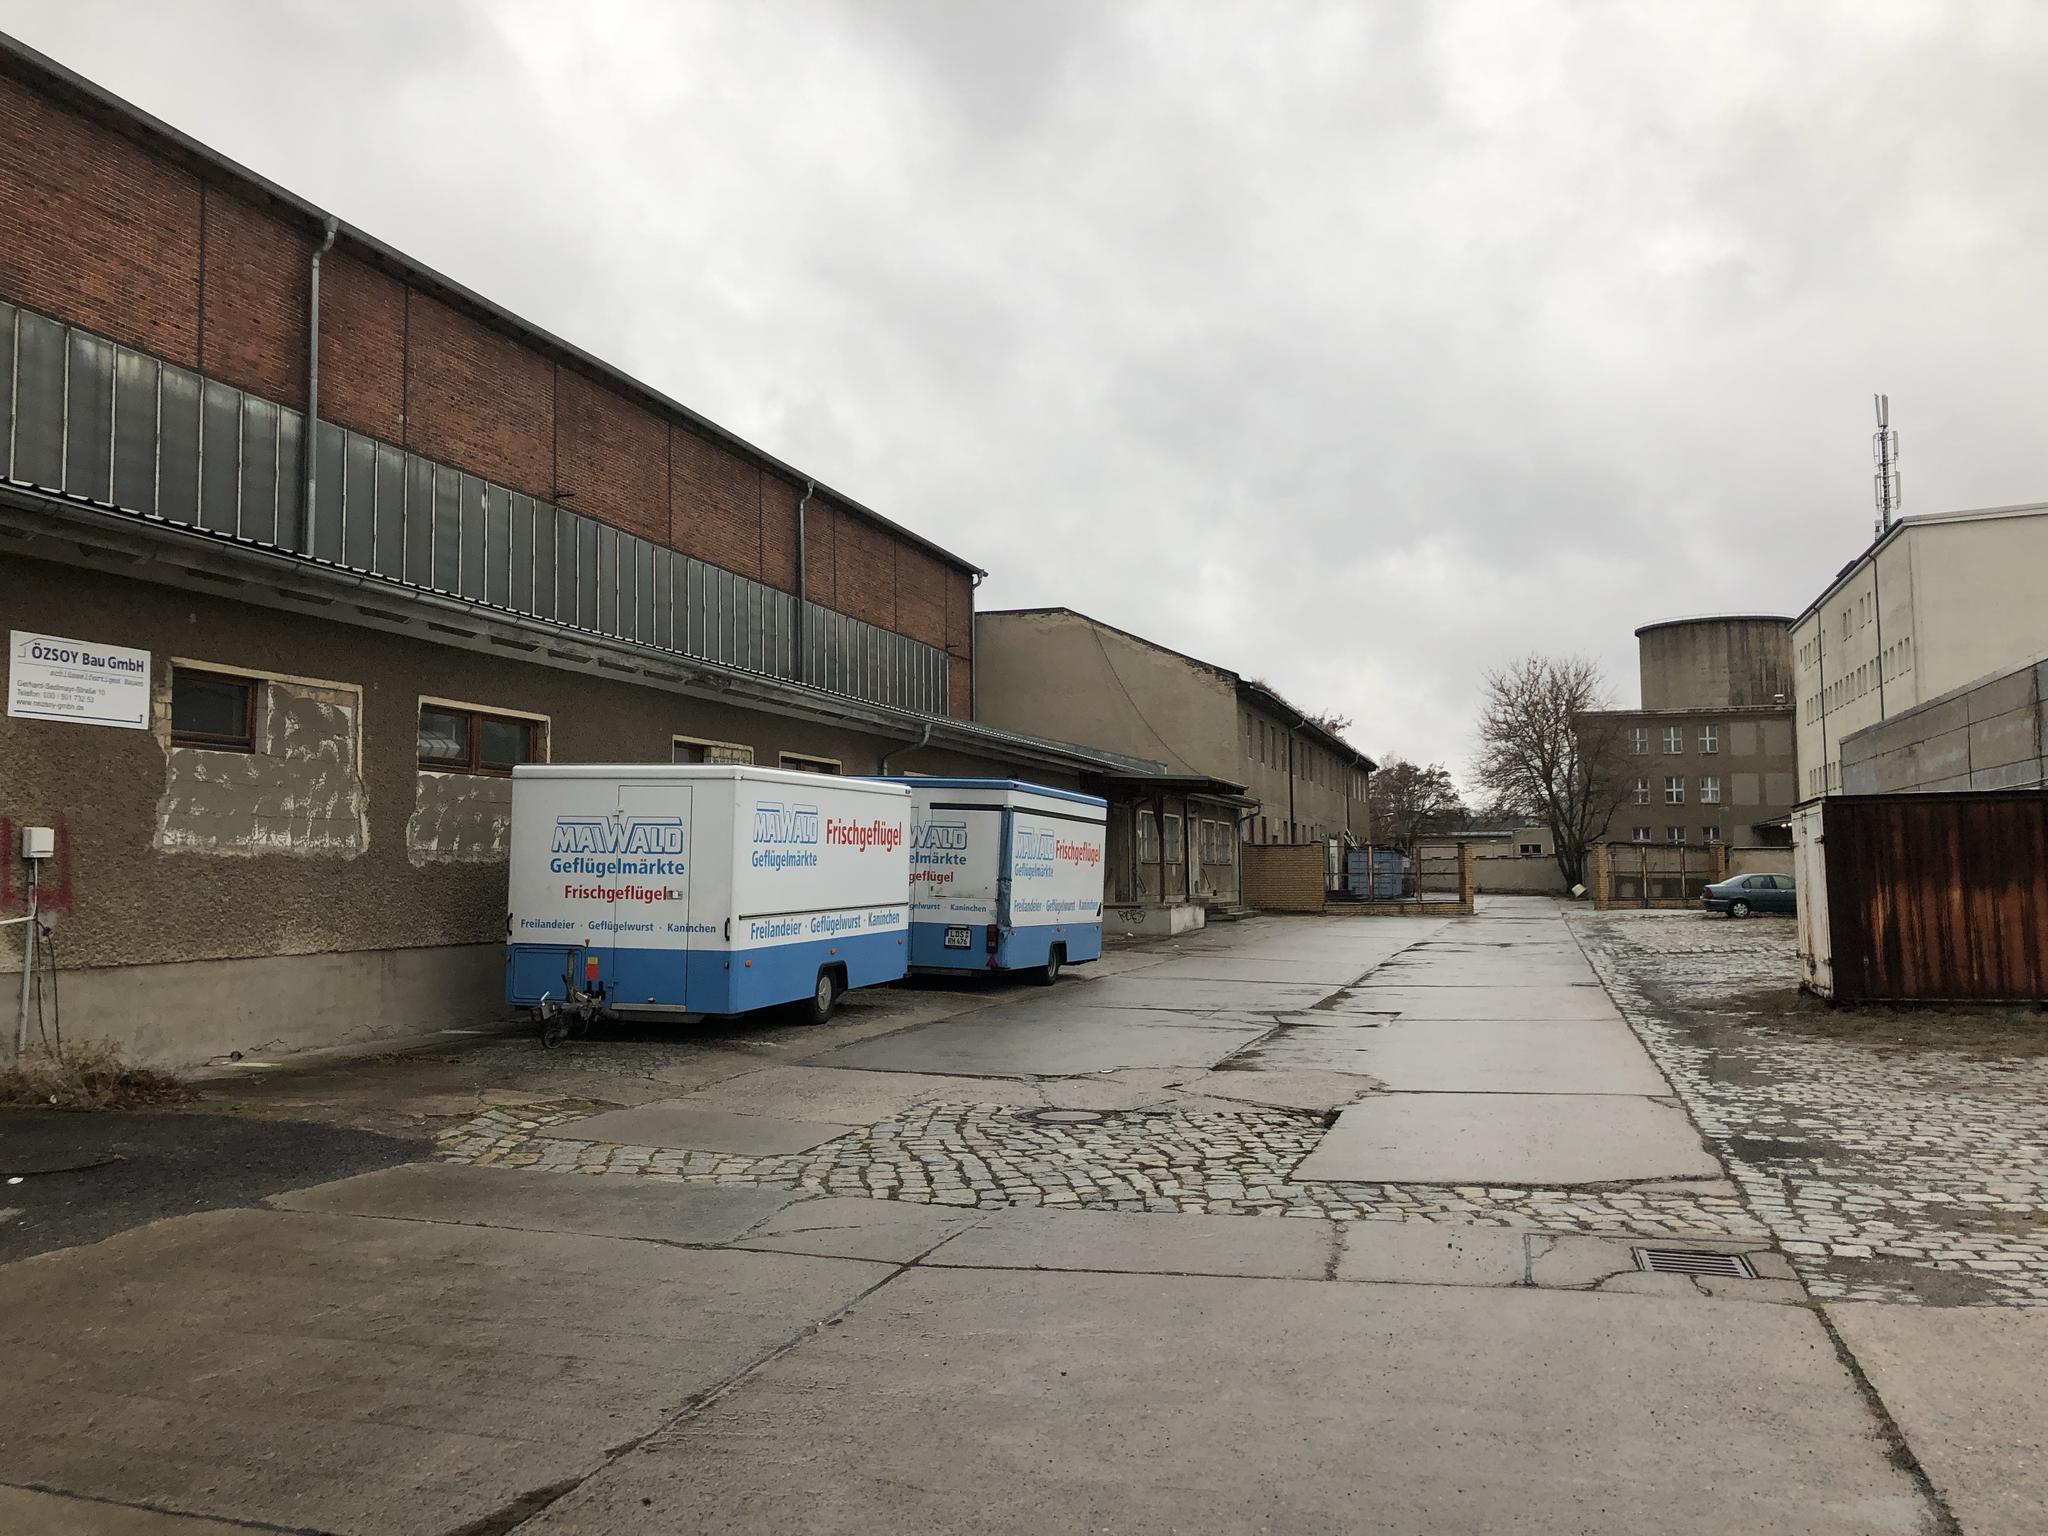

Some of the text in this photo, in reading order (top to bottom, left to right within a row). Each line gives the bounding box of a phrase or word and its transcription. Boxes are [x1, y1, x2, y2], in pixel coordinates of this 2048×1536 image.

[31, 642, 145, 673] ÖZSOY Bau GmbH
[826, 817, 902, 853] Frischgeflügel
[751, 849, 818, 872] Geflügelmärkte
[909, 851, 967, 866] elmärkte
[1055, 839, 1101, 868] Frischgeflügel
[550, 857, 685, 878] Geflügelmärkte
[909, 870, 954, 886] geflügel
[564, 885, 668, 904] Frischgeflügel
[909, 902, 987, 913] gelwurst Kaninchen
[520, 918, 717, 934] Freilandeier Geflügelwurst Kaninchen
[750, 911, 900, 941] Freilandeier Geflügelwurst Kaninchen
